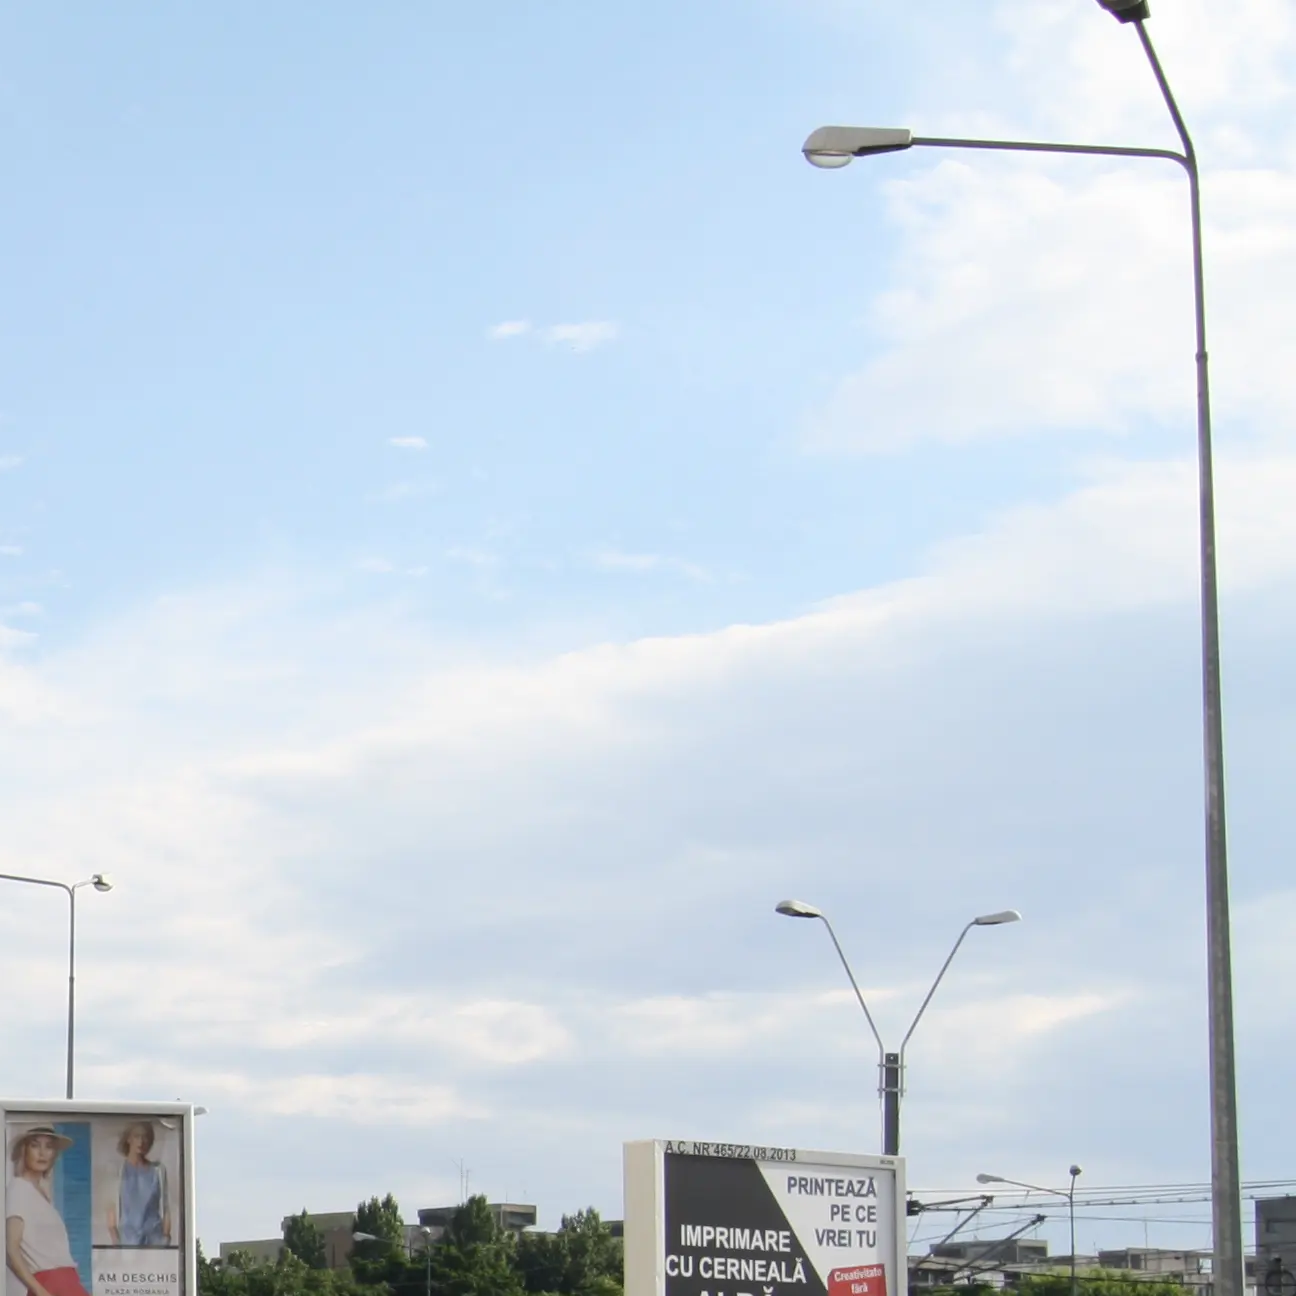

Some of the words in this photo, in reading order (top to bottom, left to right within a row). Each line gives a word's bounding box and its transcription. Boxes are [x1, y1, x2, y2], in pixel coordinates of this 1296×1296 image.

[787, 1176, 877, 1197] PRINTEAZĂ
[830, 1204, 851, 1222] PE
[855, 1204, 877, 1223] CE
[680, 1224, 791, 1252] IMPRIMARE
[815, 1228, 852, 1248] VREI
[856, 1229, 876, 1248] TU
[98, 1273, 117, 1283] AM
[122, 1273, 177, 1283] DESCHIS
[665, 1254, 693, 1277] CU
[699, 1257, 807, 1284] CERNEALĂ
